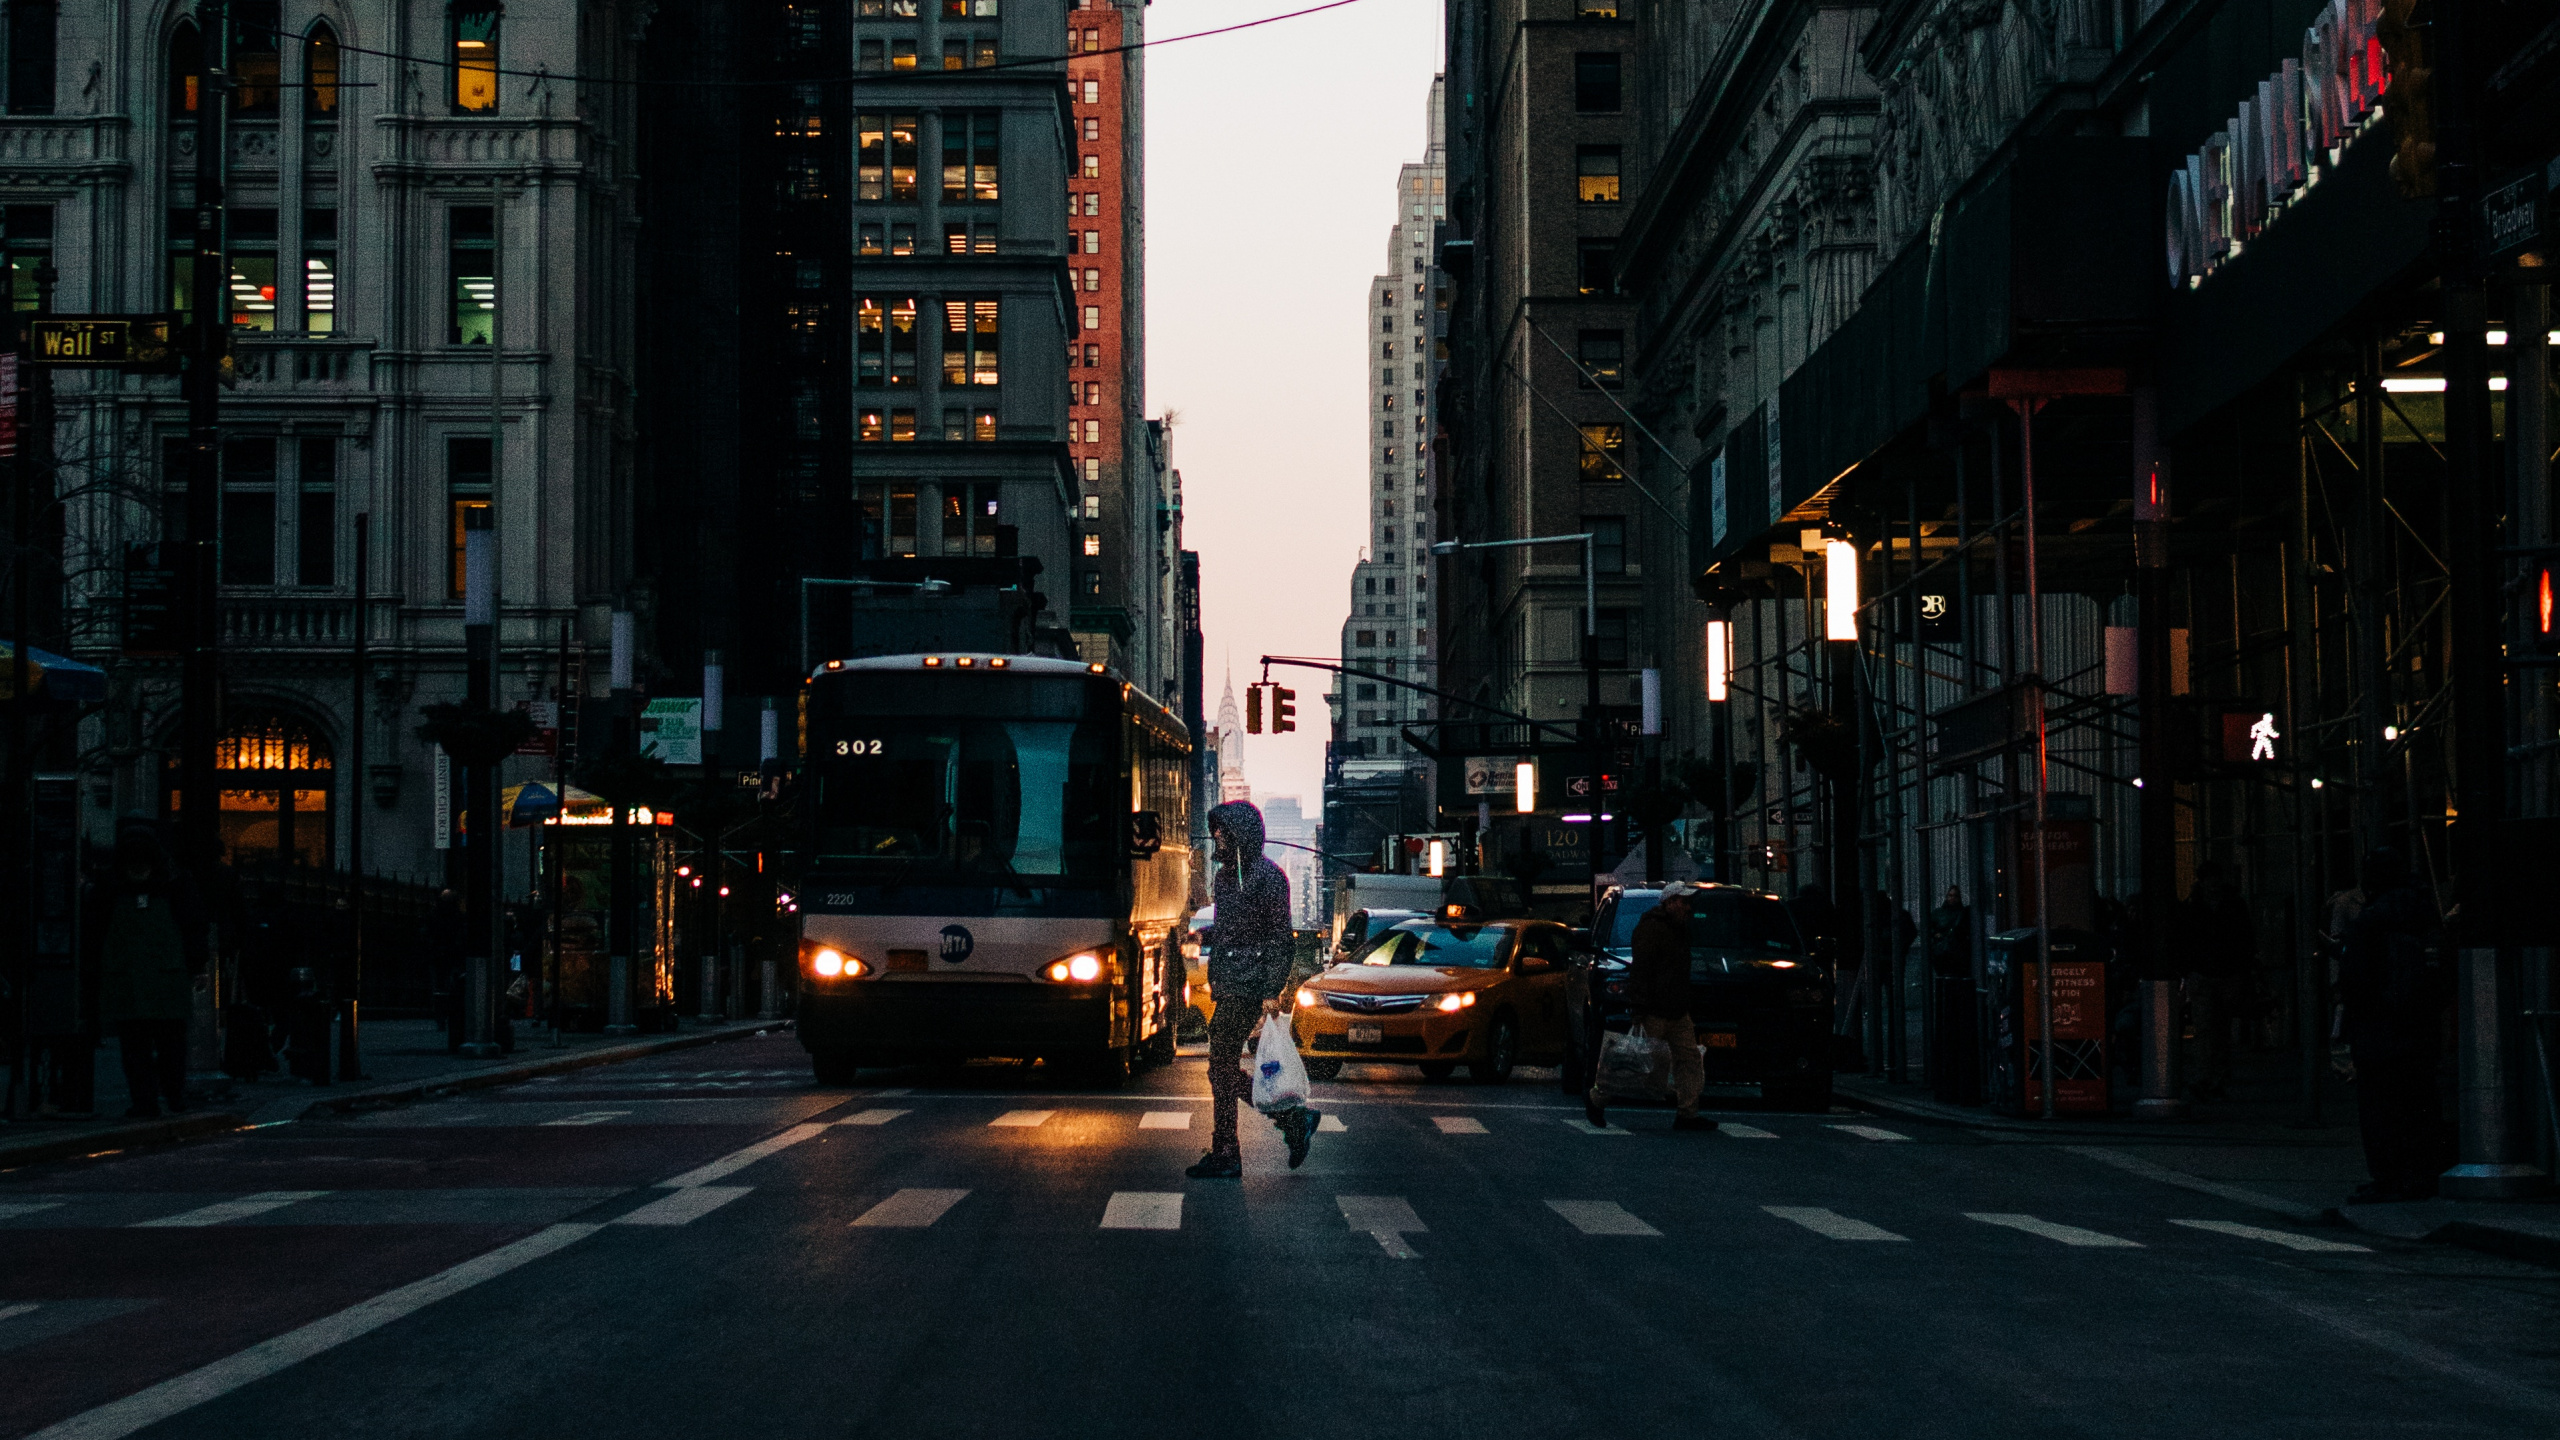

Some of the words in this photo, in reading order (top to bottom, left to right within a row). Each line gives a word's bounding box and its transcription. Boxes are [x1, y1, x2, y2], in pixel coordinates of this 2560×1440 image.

[2491, 201, 2536, 240] Broadway
[44, 331, 92, 356] Wall
[99, 331, 115, 345] ST
[641, 701, 699, 714] UBWAY
[836, 739, 884, 756] 302
[438, 796, 448, 841] CHURCH
[1546, 829, 1579, 847] 120
[826, 893, 856, 906] 2220
[940, 934, 968, 955] MTA
[2051, 968, 2087, 977] ERCELY
[2054, 978, 2096, 987] FITNESS
